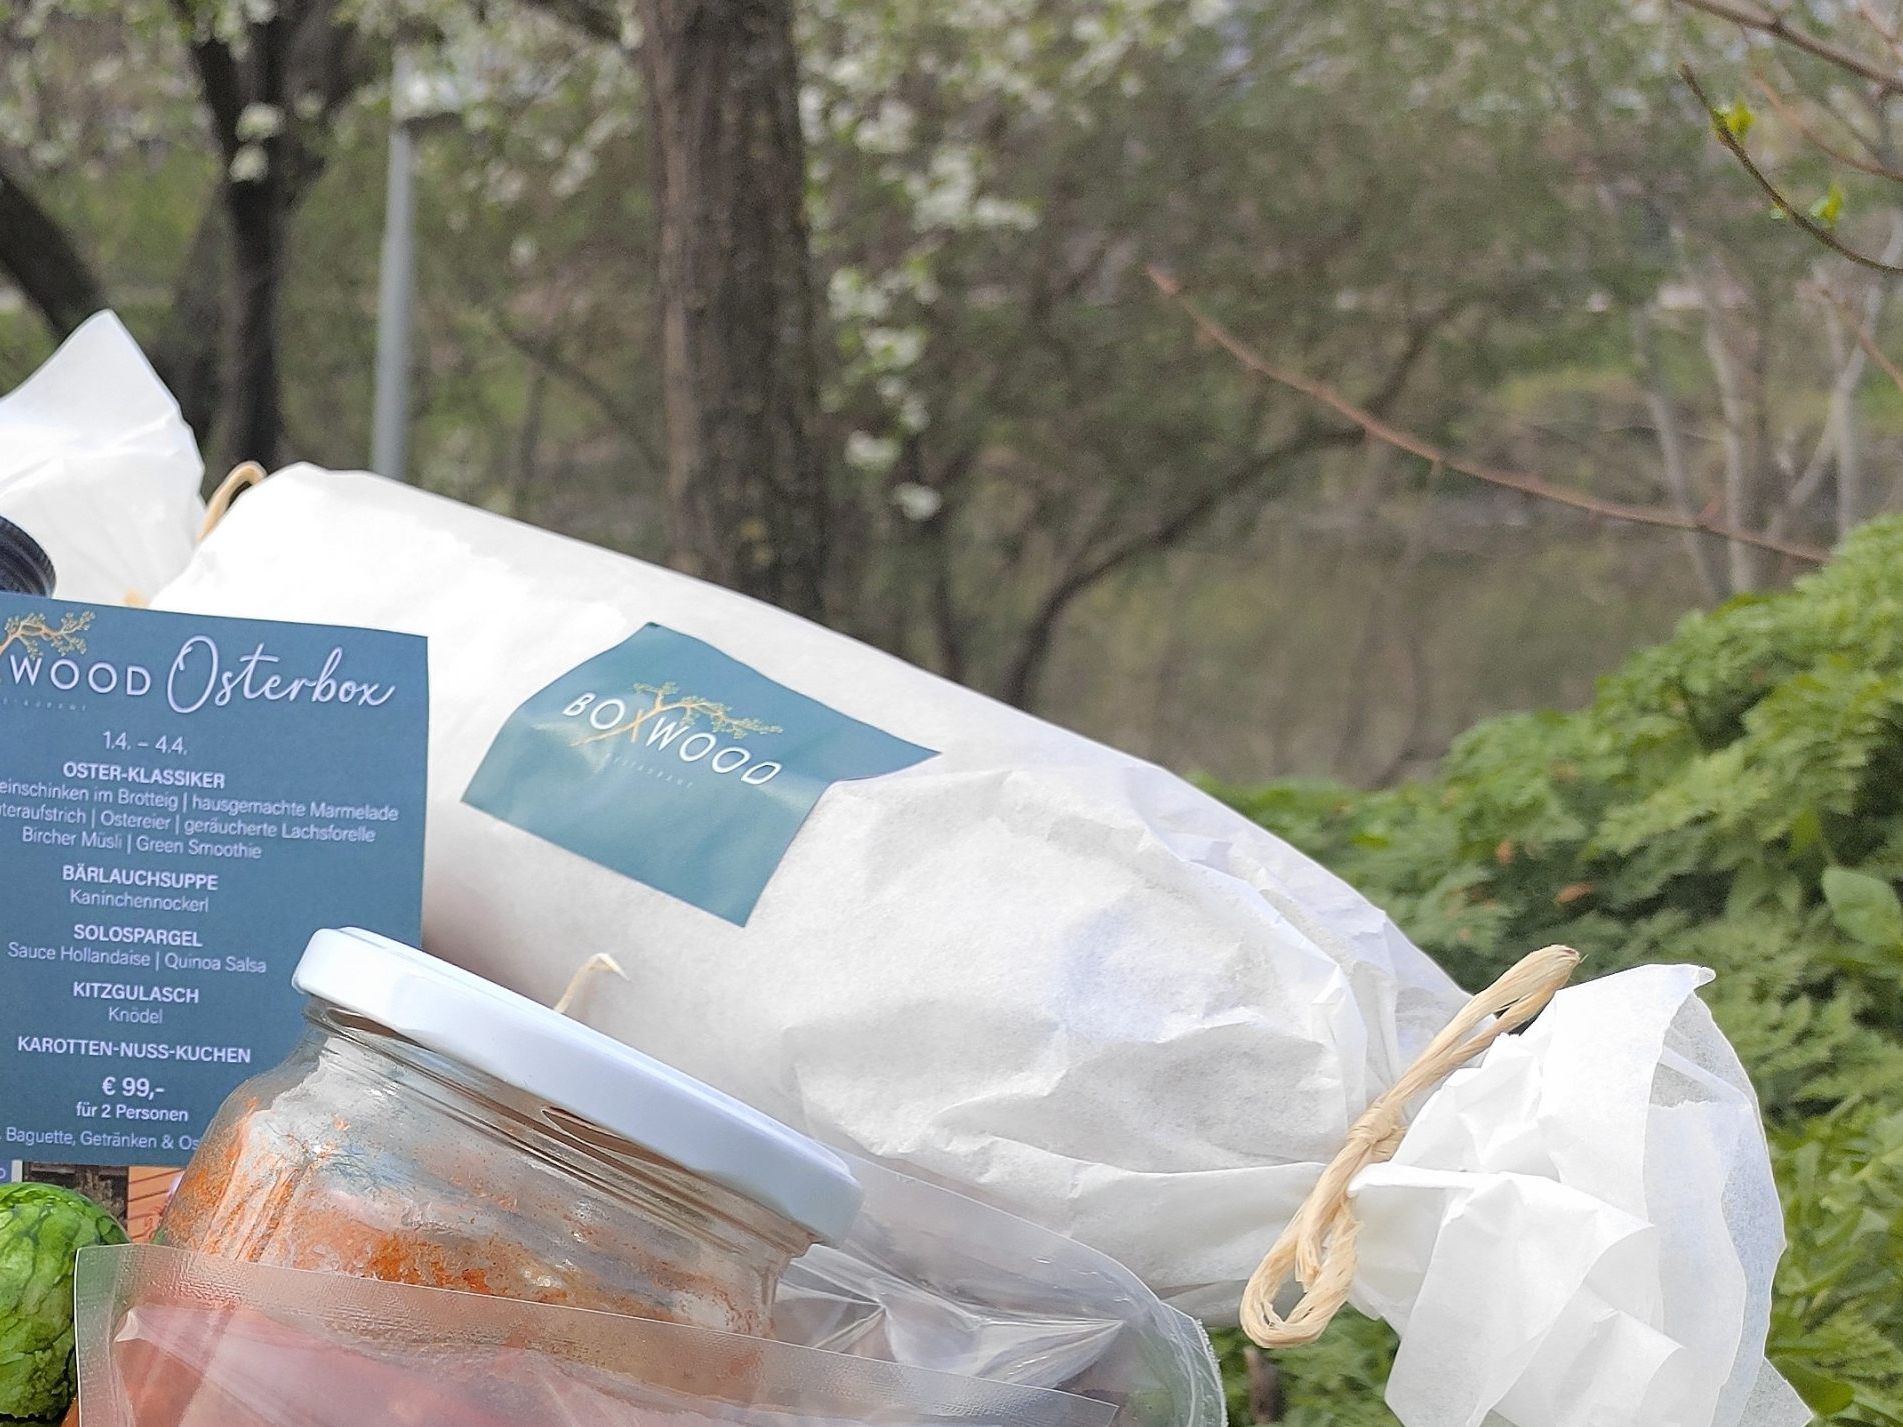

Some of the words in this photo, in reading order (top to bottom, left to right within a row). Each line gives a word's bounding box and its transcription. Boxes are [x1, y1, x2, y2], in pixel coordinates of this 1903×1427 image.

[166, 634, 396, 714] Osterbox
[154, 734, 188, 754] 4.4.
[562, 692, 784, 785] BOXWOOD
[62, 761, 226, 789] OSTER-KLASSIKER
[93, 786, 113, 803] im
[117, 788, 179, 812] Brotteig
[191, 796, 306, 818] hausgemachte
[309, 801, 399, 821] Marmelade
[100, 809, 171, 830] Ostereier
[184, 817, 277, 839] geräucherte
[281, 823, 377, 843] Lachsforelle
[21, 826, 77, 846] Bircher
[81, 830, 123, 849] Müsli
[136, 836, 184, 854] Green
[187, 839, 263, 860] Smoothie
[61, 863, 219, 890] BÄRLAUCHSUPPE
[69, 887, 210, 912] Kaninchennockerl
[73, 923, 203, 947] SOLOSPARGEL
[7, 942, 56, 960] Sauce
[60, 945, 151, 966] Hollandaise
[164, 952, 222, 971] Quinoa
[225, 956, 267, 973] Salsa
[72, 981, 199, 1003] KITZGULASCH
[108, 1006, 164, 1024] Knödel
[17, 1035, 251, 1063] KAROTTEN-NUSS-KUCHEN
[102, 1076, 116, 1096] €
[75, 1101, 98, 1118] für
[101, 1103, 111, 1118] 2
[115, 1105, 190, 1122] Personen
[5, 1126, 77, 1147] Baguette,
[79, 1130, 158, 1149] Getränken
